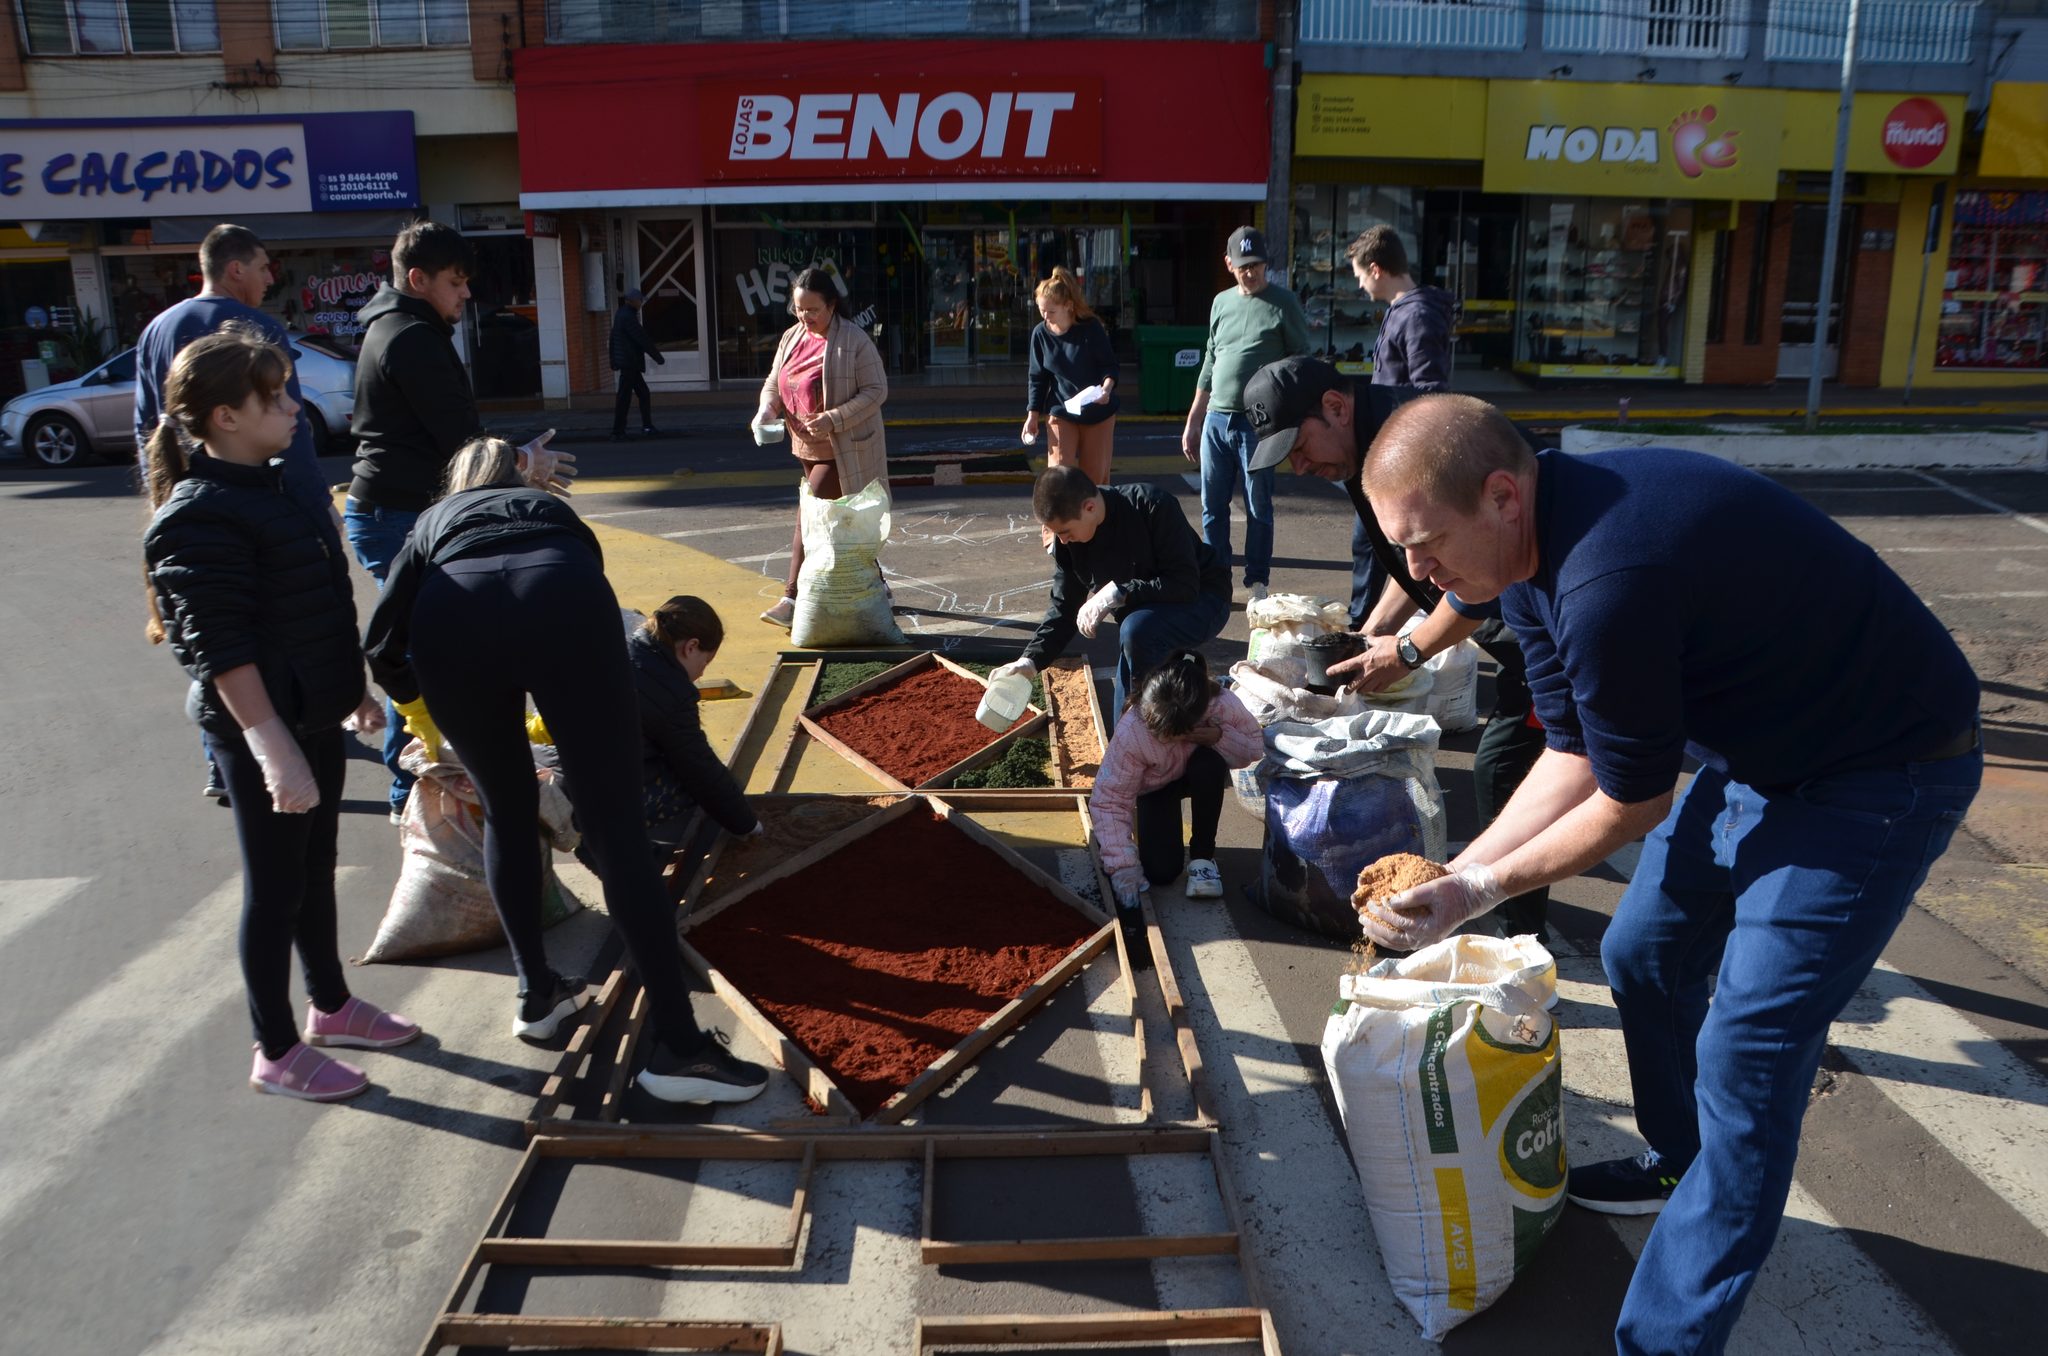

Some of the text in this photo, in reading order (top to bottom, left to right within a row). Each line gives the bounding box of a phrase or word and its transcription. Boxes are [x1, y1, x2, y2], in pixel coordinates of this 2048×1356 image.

[729, 91, 1076, 160] BENOIT
[733, 98, 754, 155] LOJAS
[1525, 124, 1659, 164] MODA
[0, 147, 295, 202] E CALÇADOS
[314, 312, 350, 322] COURO
[1427, 1030, 1446, 1129] Concentrados
[1450, 1223, 1468, 1271] AVES
